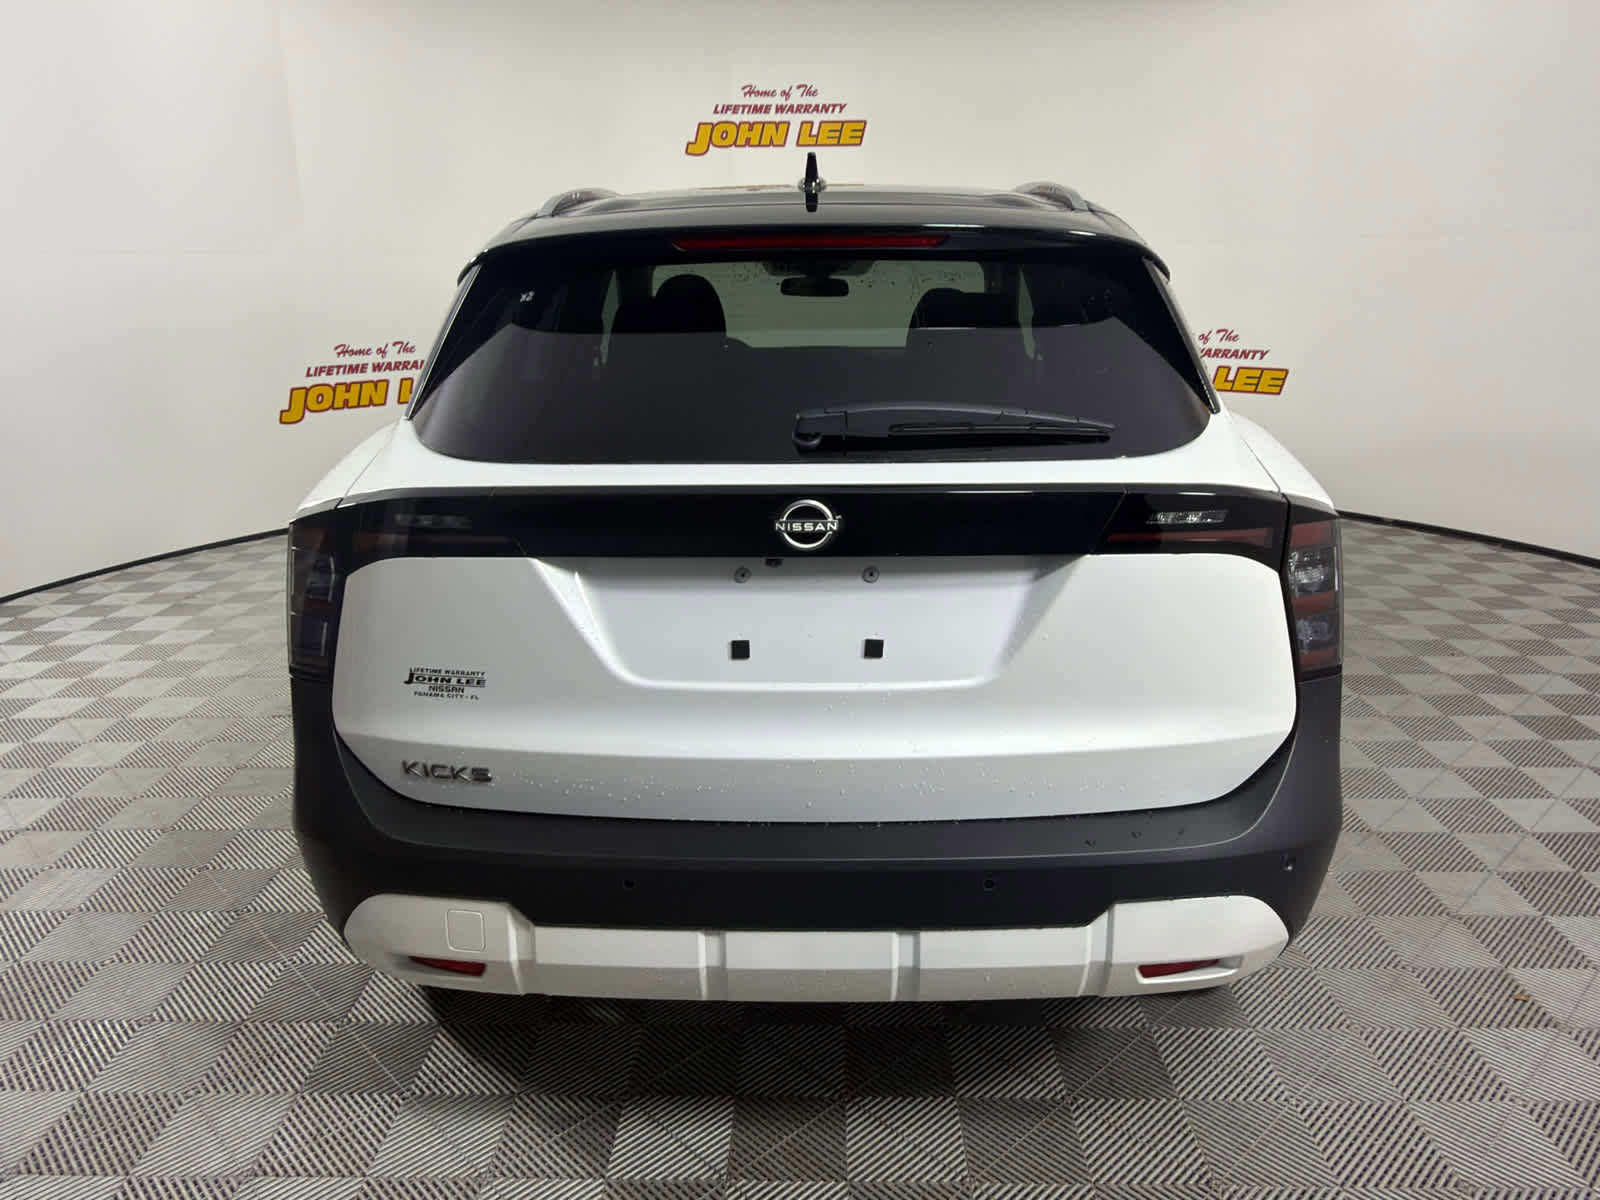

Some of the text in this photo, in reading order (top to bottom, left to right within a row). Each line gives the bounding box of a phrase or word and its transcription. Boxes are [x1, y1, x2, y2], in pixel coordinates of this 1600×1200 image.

[741, 83, 819, 101] Home of The
[713, 103, 847, 115] LIFETIME WARRANTY
[686, 120, 867, 155] JOHN LEE
[1198, 329, 1239, 345] of The
[333, 340, 416, 359] Home of The
[305, 364, 368, 377] LIFETIME
[1213, 365, 1289, 395] LEE
[280, 380, 389, 424] JOHN
[775, 522, 838, 531] NISSAN
[403, 672, 487, 687] JOHN LEE
[428, 685, 465, 694] NISSAN
[402, 760, 492, 782] KICKS
